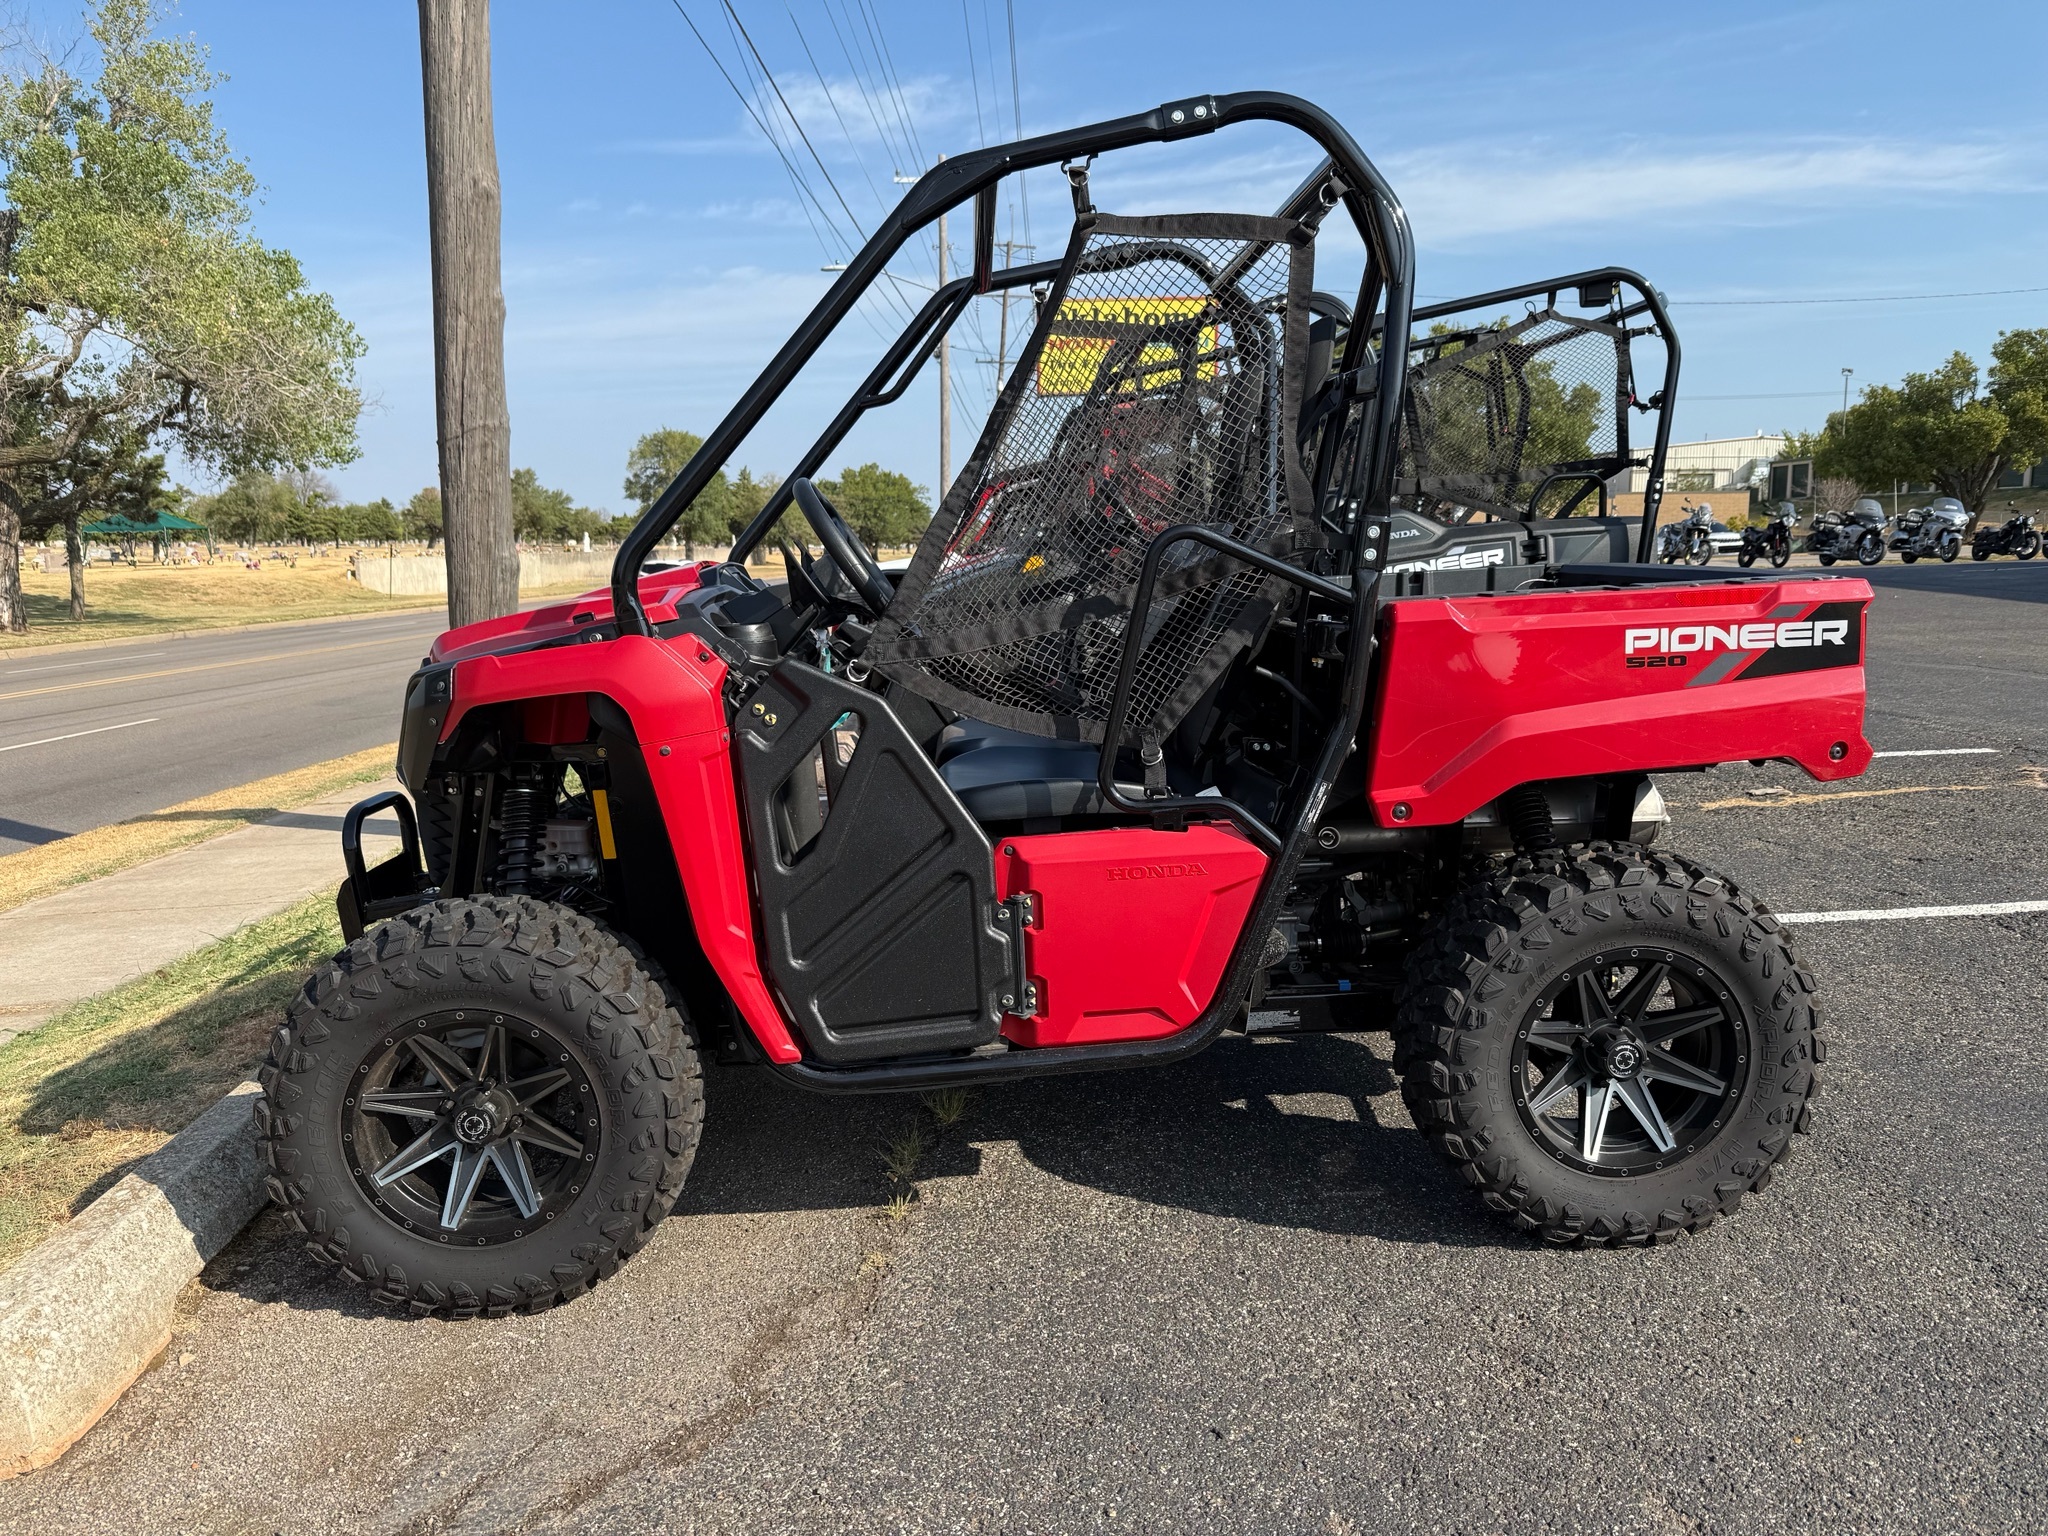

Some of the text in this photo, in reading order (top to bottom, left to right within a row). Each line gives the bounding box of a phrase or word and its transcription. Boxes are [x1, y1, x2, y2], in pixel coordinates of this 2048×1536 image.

[1057, 307, 1202, 326] klahom
[1390, 529, 1420, 540] NDA
[1383, 548, 1504, 573] IONEER
[1625, 620, 1849, 654] PIONEER
[1626, 655, 1687, 668] 520
[1107, 863, 1208, 881] HONDA
[1485, 959, 1557, 1113] FEDERAL
[1745, 1005, 1781, 1119] XPLORA
[573, 1033, 627, 1150] XPLORA
[307, 1053, 358, 1217] FEDERAL
